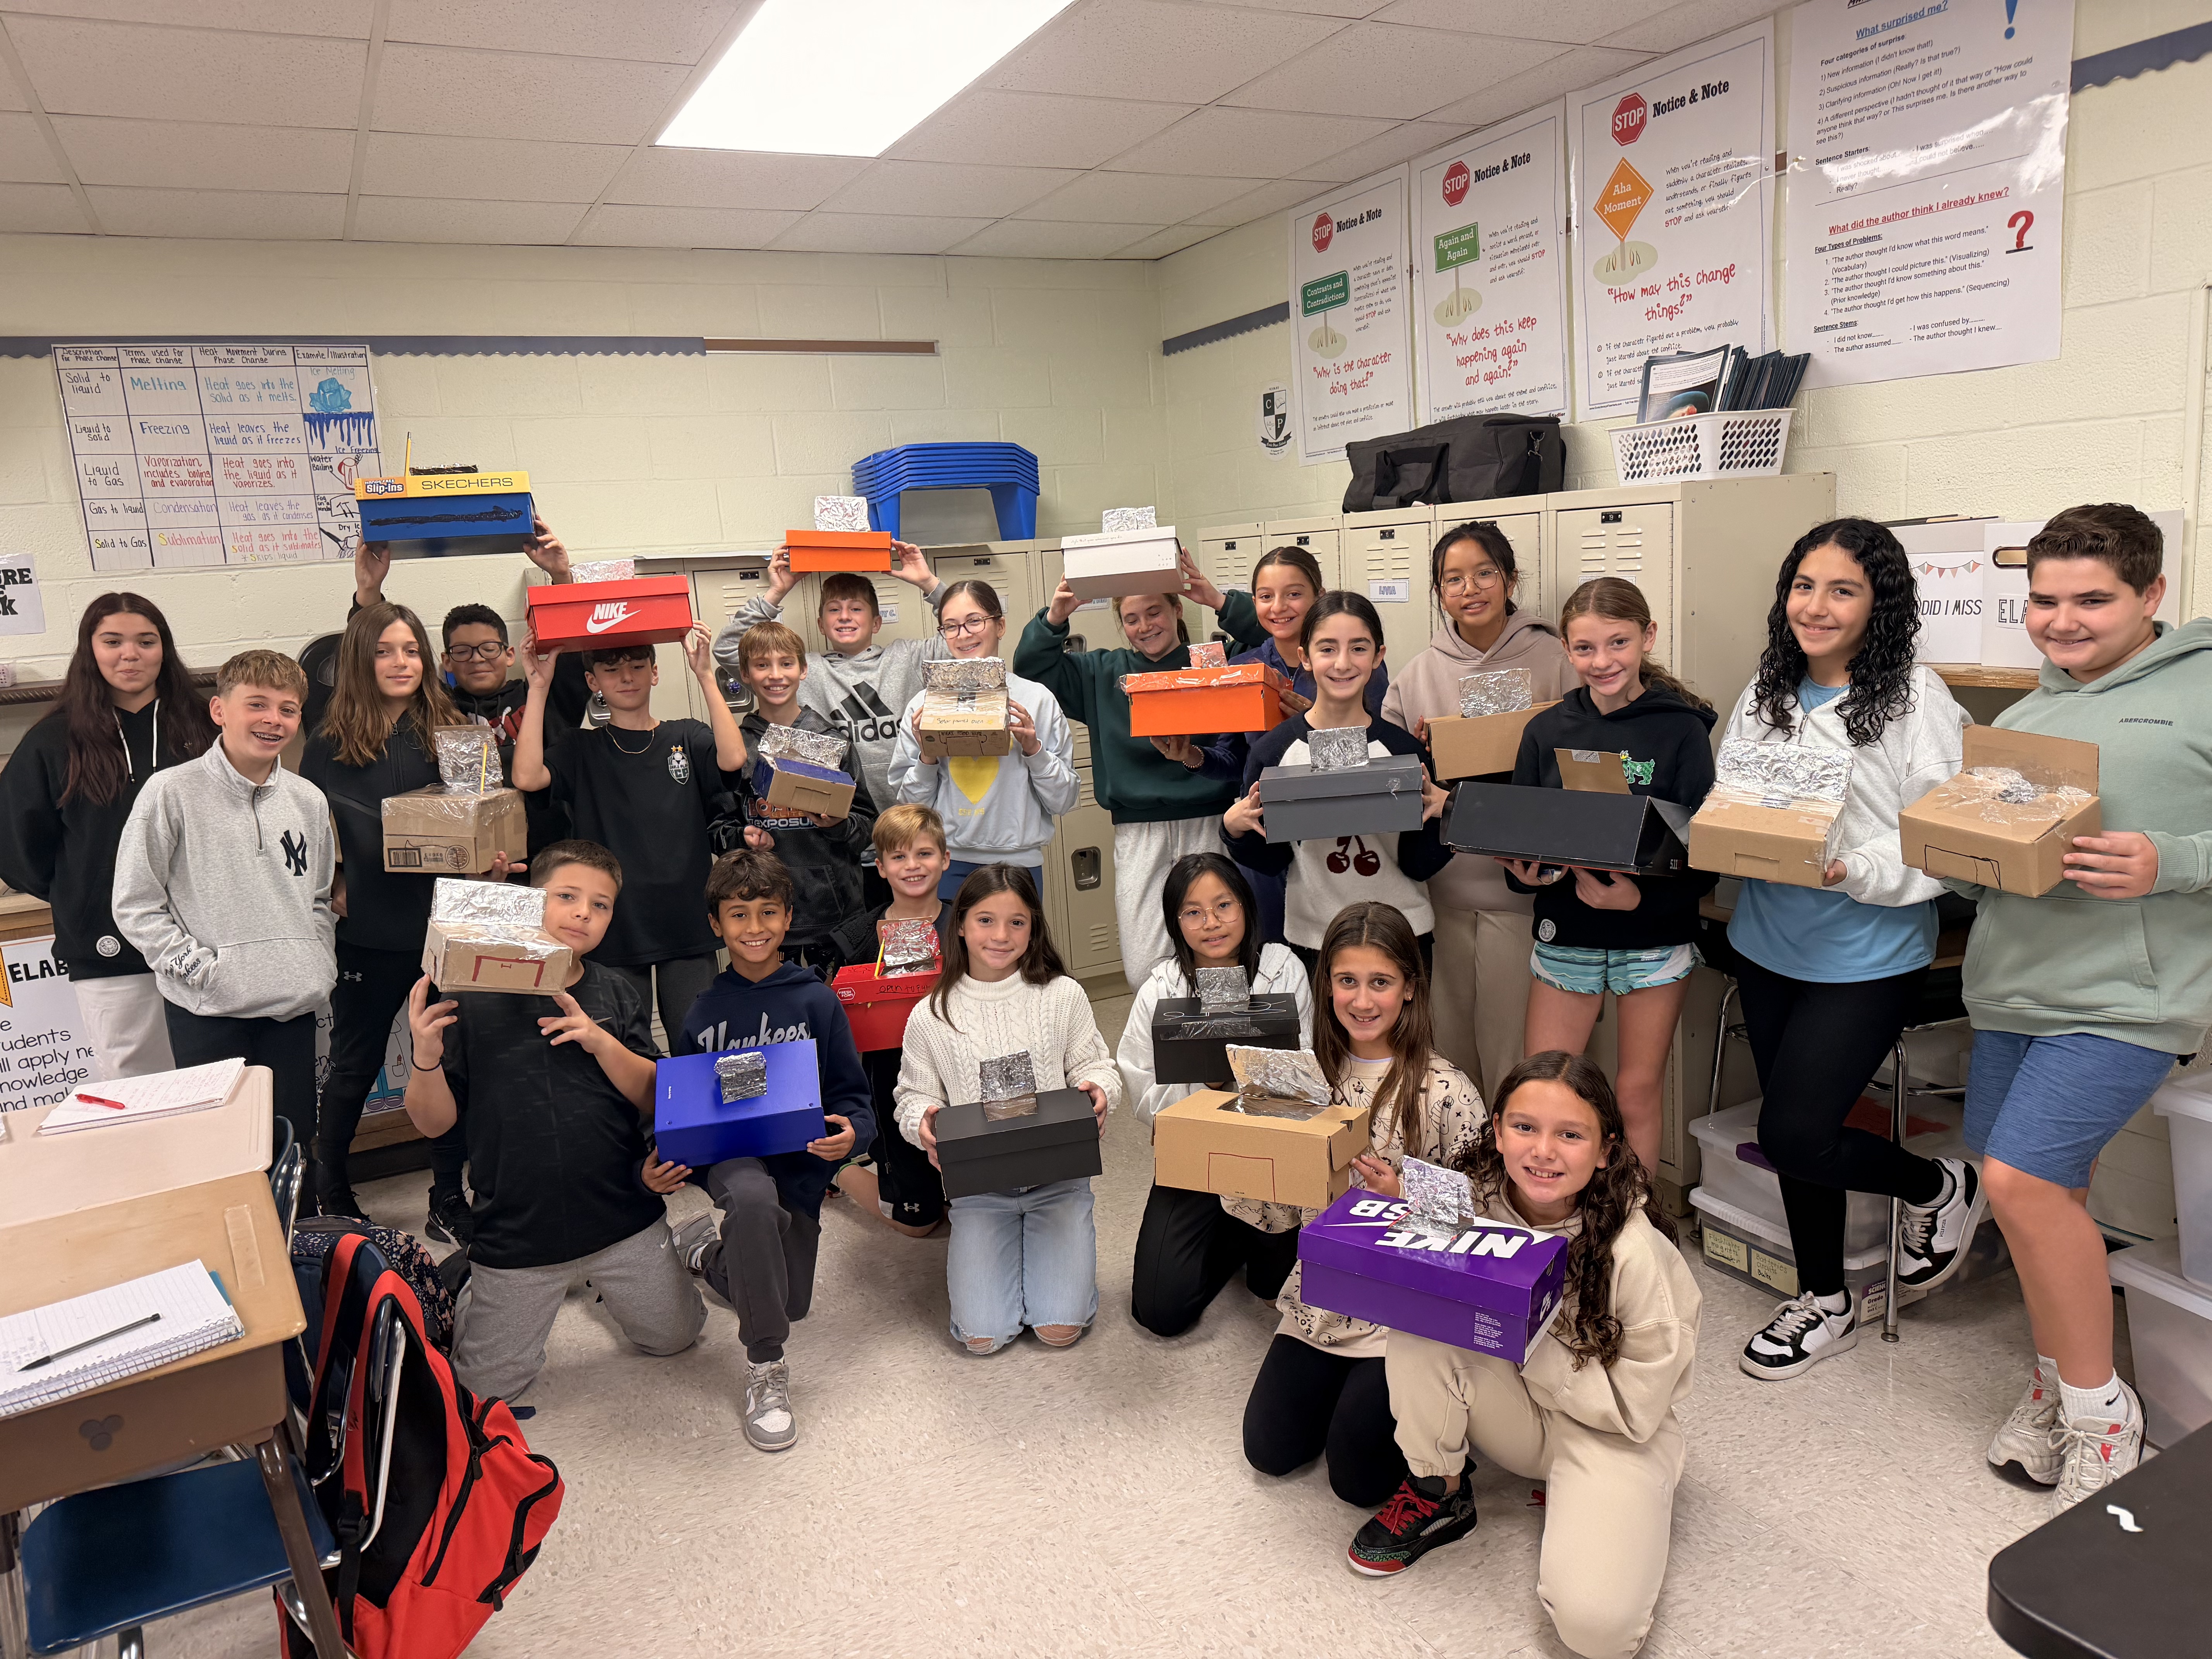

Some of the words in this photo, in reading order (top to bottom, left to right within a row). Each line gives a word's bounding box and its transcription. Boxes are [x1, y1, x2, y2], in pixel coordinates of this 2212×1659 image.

[1856, 24, 1879, 38] What
[1881, 9, 1924, 30] surprised
[1927, 0, 1948, 15] me?
[1652, 97, 1686, 118] Notice
[1689, 89, 1698, 105] &
[1701, 81, 1730, 99] Note
[1614, 108, 1645, 132] STOP
[1474, 165, 1500, 183] Notice
[1503, 159, 1509, 172] &
[1511, 152, 1530, 170] Note
[1666, 166, 1679, 175] When
[1681, 160, 1698, 171] you're
[1700, 154, 1720, 165] reading
[1722, 148, 1732, 159] and
[1666, 177, 1688, 188] suddenly
[1696, 167, 1721, 180] character
[1724, 160, 1748, 172] realizes,
[1444, 173, 1468, 195] STOP
[1613, 182, 1632, 196] Aha
[1604, 196, 1641, 215] Moment
[1828, 224, 1849, 235] What
[1851, 218, 1863, 229] did
[1866, 216, 1879, 226] the
[1881, 210, 1910, 223] author
[1911, 203, 1933, 217] think
[1936, 203, 1940, 211] I
[1942, 196, 1975, 211] already
[1977, 187, 2009, 203] knew?
[1336, 218, 1357, 232] Notice
[1359, 214, 1364, 224] &
[1365, 208, 1382, 222] Note
[1314, 224, 1331, 242] STOP
[1438, 237, 1459, 250] Again
[1461, 228, 1474, 241] and
[1815, 244, 1827, 253] Four
[1828, 243, 1844, 252] Types
[1853, 234, 1883, 246] Problems:
[1447, 248, 1468, 261] Again
[1307, 281, 1332, 297] Contrasts
[1333, 278, 1343, 288] and
[1640, 282, 1662, 299] may
[1666, 273, 1691, 293] this
[1696, 261, 1736, 289] change
[1306, 290, 1345, 309] Contradictions
[1472, 327, 1491, 342] does
[1494, 319, 1514, 337] this
[1518, 315, 1537, 331] keep
[1814, 322, 1838, 333] Sentence
[1839, 319, 1858, 328] Stems:
[173, 349, 183, 357] for
[199, 348, 218, 356] Heat
[226, 348, 257, 356] Movement
[263, 347, 286, 357] During
[214, 353, 235, 364] Phase
[1456, 347, 1497, 368] happening
[1501, 339, 1527, 358] again
[1333, 359, 1341, 376] is
[1343, 361, 1355, 373] the
[1357, 352, 1391, 370] character
[66, 371, 90, 383] Solid
[100, 372, 110, 381] to
[311, 368, 319, 376] Ice
[326, 367, 354, 380] Melting
[1465, 372, 1479, 386] and
[72, 383, 101, 393] liquid
[130, 377, 186, 390] Melting
[1329, 383, 1347, 396] doing
[1266, 399, 1272, 409] C
[76, 423, 100, 433] Liquid
[103, 423, 111, 433] to
[139, 422, 190, 434] Freezing
[1277, 418, 1283, 428] P
[84, 462, 119, 476] Liquid
[188, 469, 211, 478] boiling
[170, 479, 214, 487] evaporation
[367, 484, 402, 493] Slip-ins
[422, 478, 513, 490] SKECHERS
[89, 502, 107, 514] Gas
[111, 503, 118, 514] to
[124, 502, 144, 514] liquid
[154, 501, 217, 513] Condensation
[95, 539, 115, 548] Solid
[119, 538, 127, 547] to
[131, 536, 147, 547] Gas
[159, 531, 221, 546] Sublimation
[0, 568, 33, 585] RE
[593, 602, 627, 620] NIKE
[1921, 600, 1941, 615] DID
[1945, 600, 1948, 614] I
[1952, 599, 1982, 615] MISS
[2119, 718, 2173, 726] ABERCROMBIE
[170, 945, 192, 969] York
[0, 1029, 71, 1051] udents
[18, 1049, 69, 1071] apply
[0, 1068, 88, 1093] nowledge
[1375, 1228, 1528, 1259] NIKE
